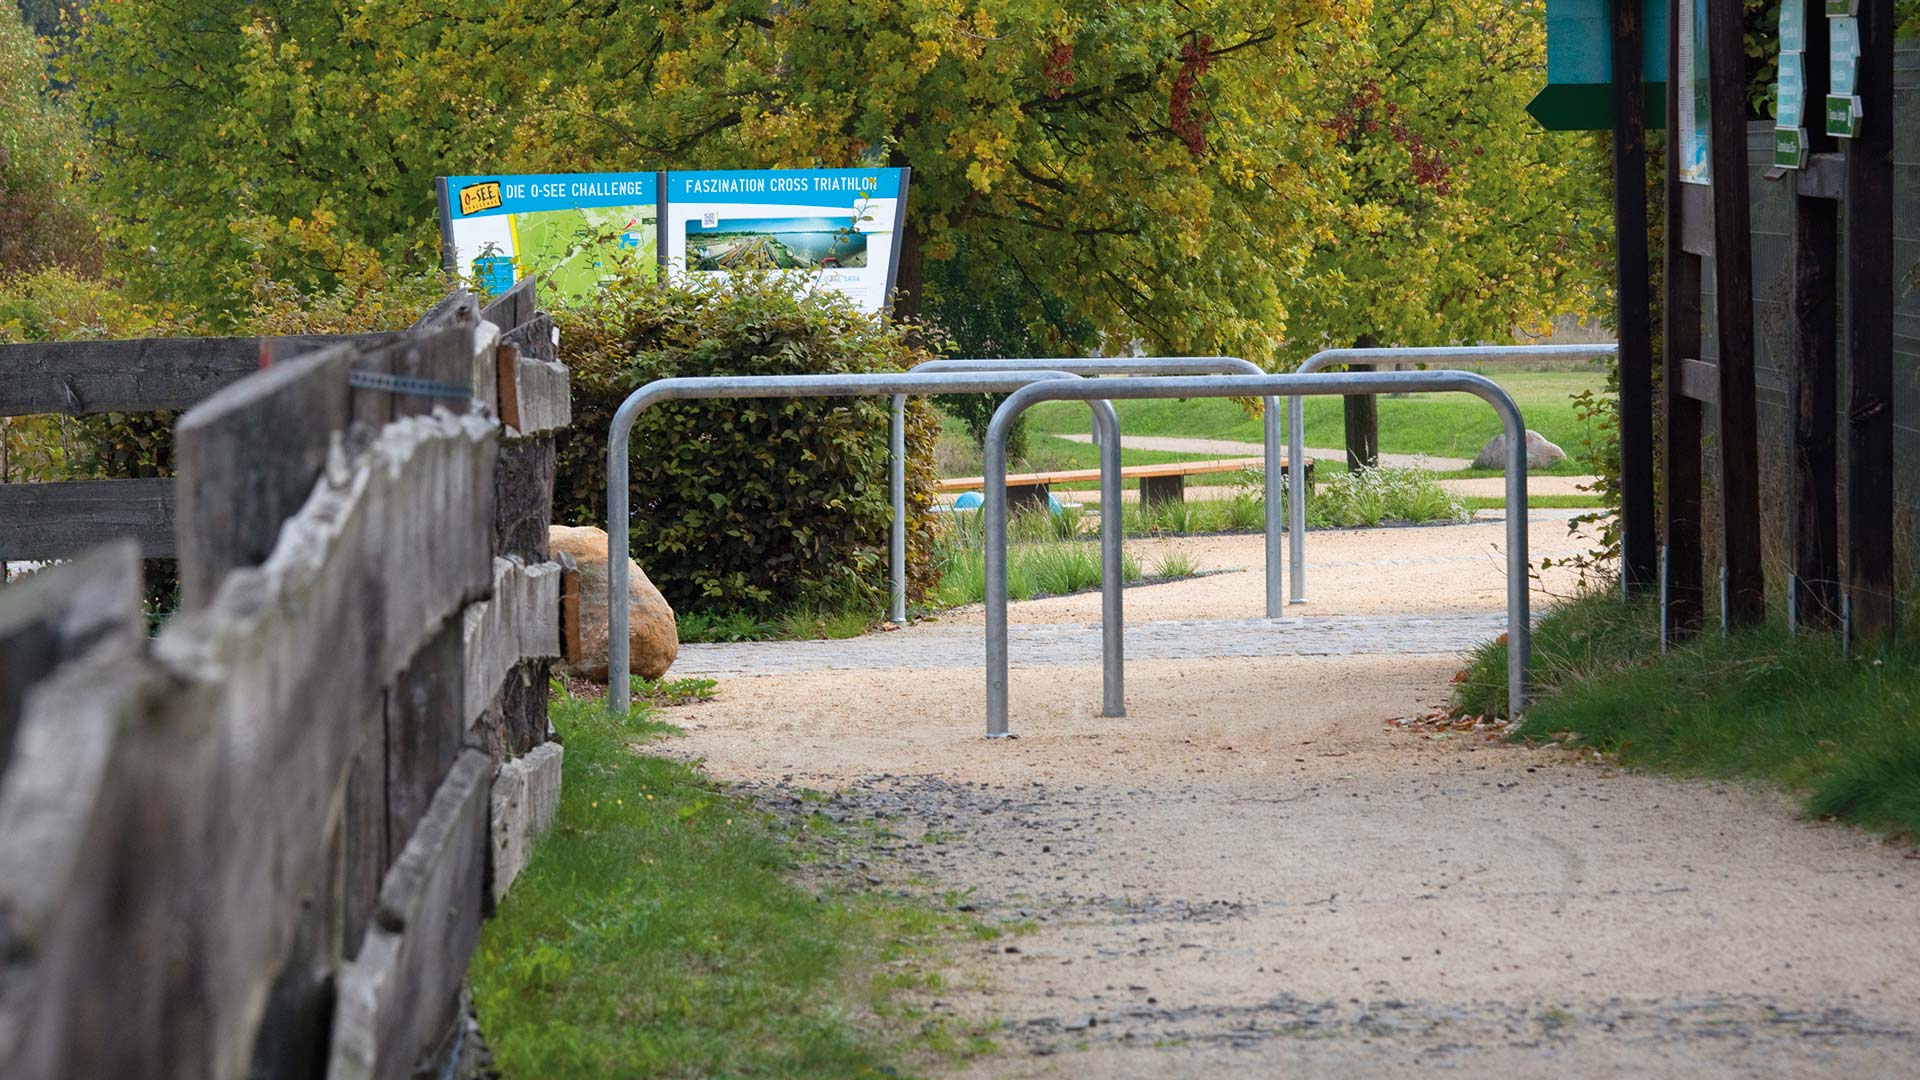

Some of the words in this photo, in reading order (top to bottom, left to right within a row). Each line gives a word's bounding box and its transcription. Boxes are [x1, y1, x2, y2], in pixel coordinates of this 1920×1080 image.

[506, 184, 525, 199] DIE
[531, 183, 566, 198] O-SEE
[571, 181, 643, 197] CHALLENGE
[685, 178, 765, 193] FASZINATION
[770, 177, 809, 192] CROSS
[814, 176, 877, 191] TRIATHLON
[465, 185, 496, 206] O-SEE
